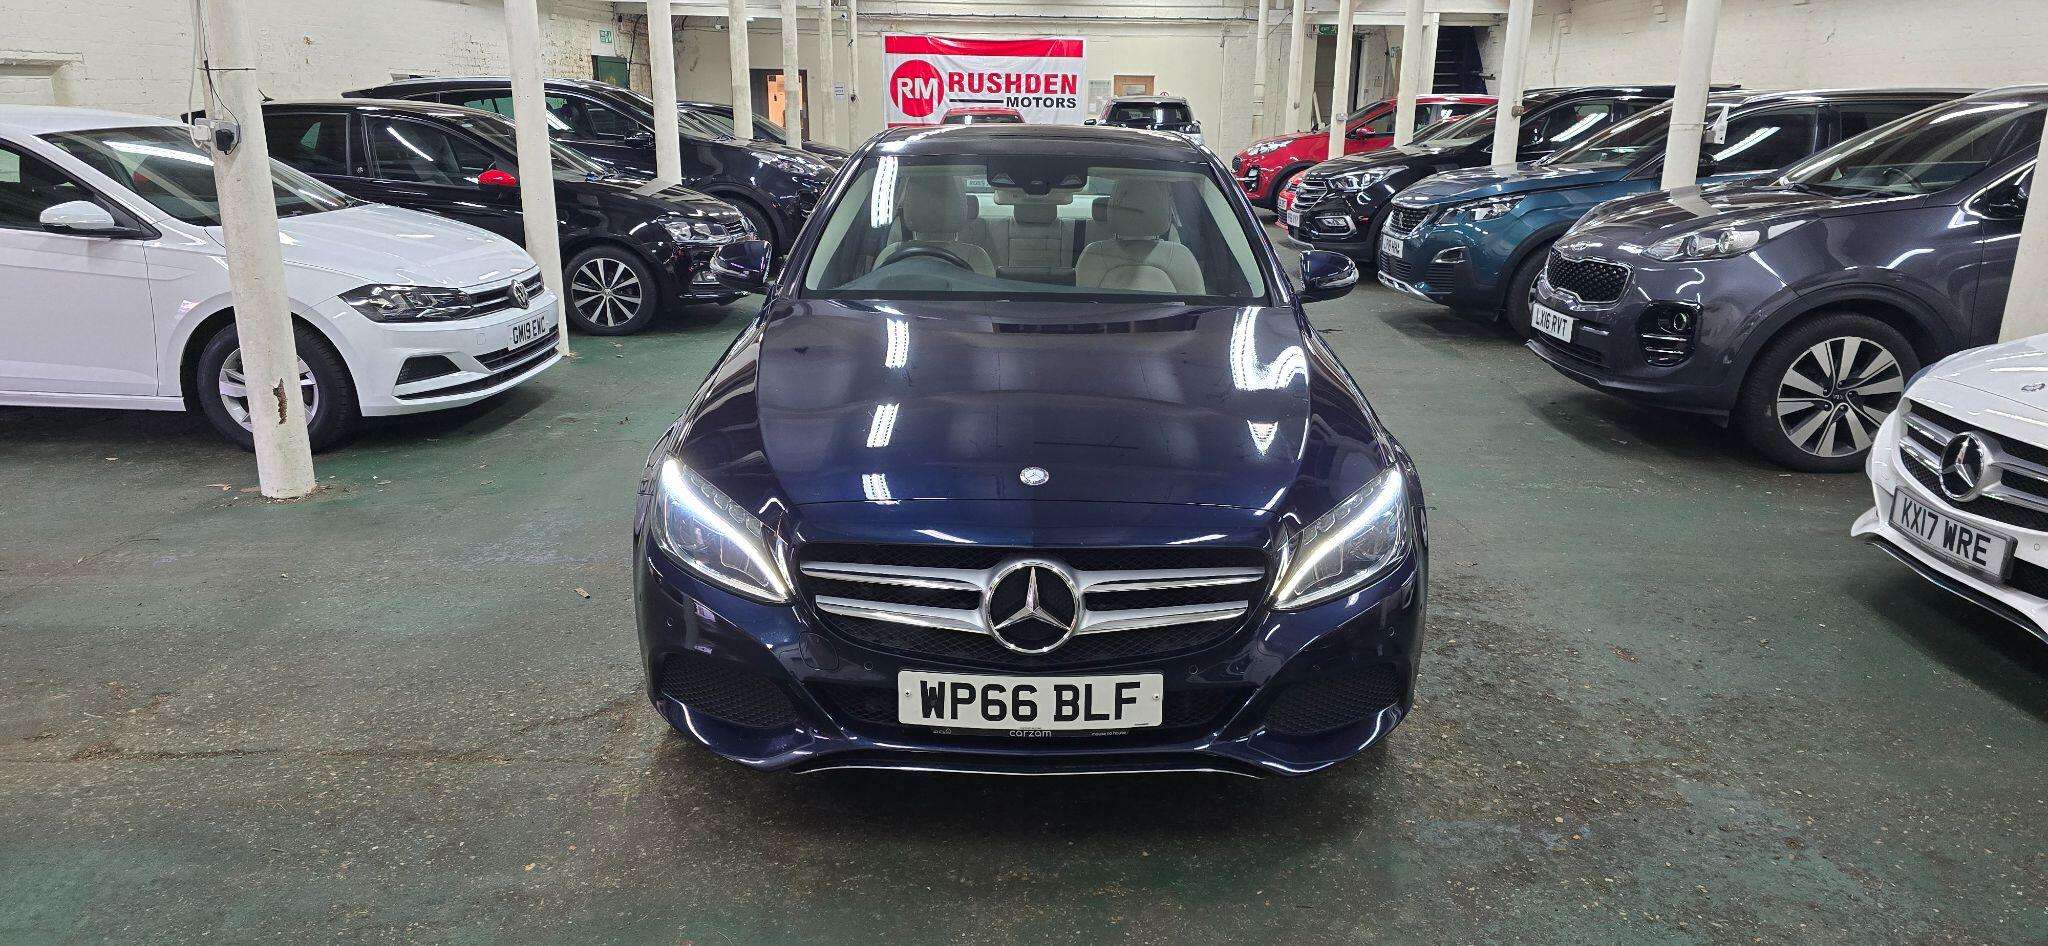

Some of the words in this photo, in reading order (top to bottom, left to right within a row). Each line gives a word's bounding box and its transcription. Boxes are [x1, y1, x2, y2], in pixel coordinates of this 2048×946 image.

[897, 77, 939, 107] RM
[949, 72, 1077, 95] RUSHDEN
[1006, 96, 1077, 109] MOTORS
[512, 321, 531, 345] GM19
[1536, 308, 1551, 329] LX16
[1551, 314, 1567, 336] RVT
[1901, 497, 1939, 541] KX17
[1943, 520, 1991, 567] WRE
[920, 680, 1038, 722] WP66
[1053, 681, 1141, 722] BLF
